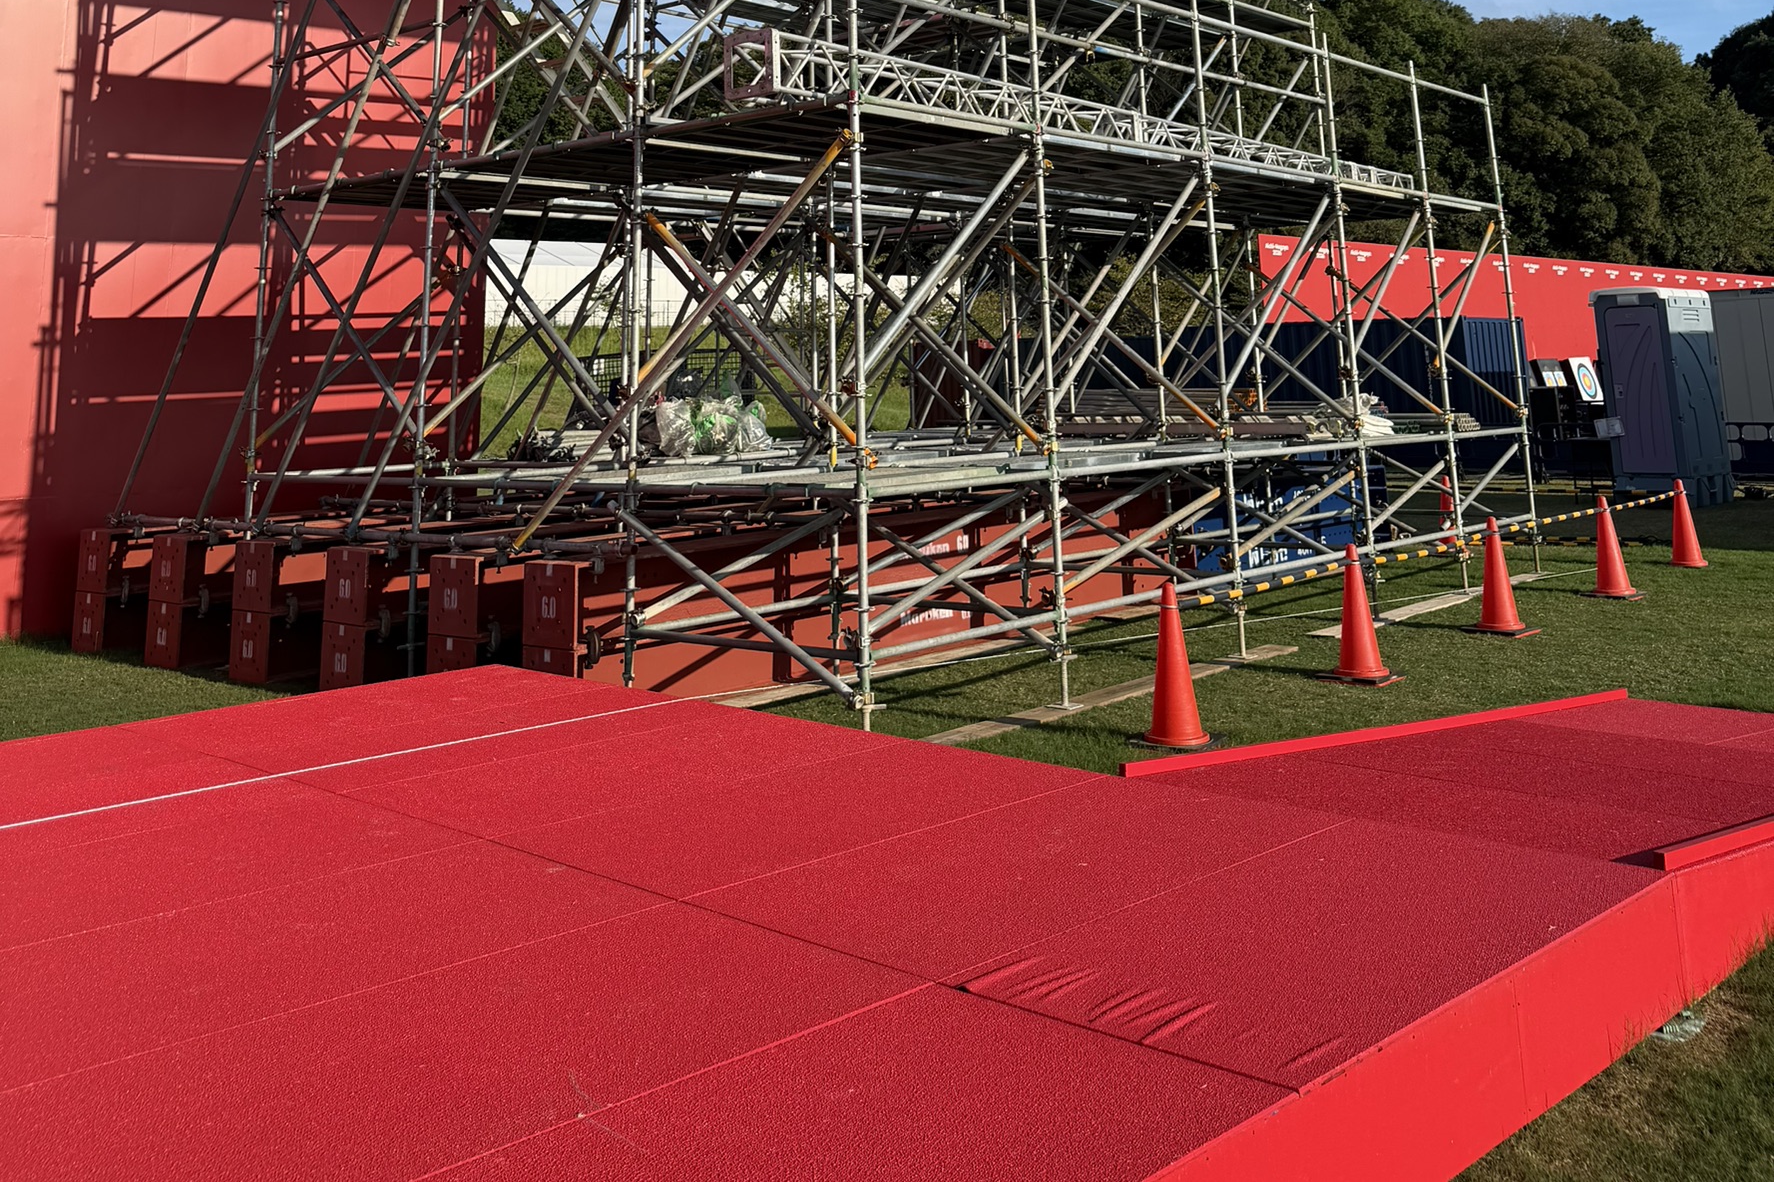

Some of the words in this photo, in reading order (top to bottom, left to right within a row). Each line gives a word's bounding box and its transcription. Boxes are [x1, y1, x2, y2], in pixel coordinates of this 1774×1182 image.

[246, 569, 257, 587] 6.0
[339, 578, 351, 598] 6.0
[443, 587, 458, 610] 6.0
[541, 595, 556, 619] 6.0
[242, 639, 254, 659] 6.0
[334, 652, 347, 674] 6.0
